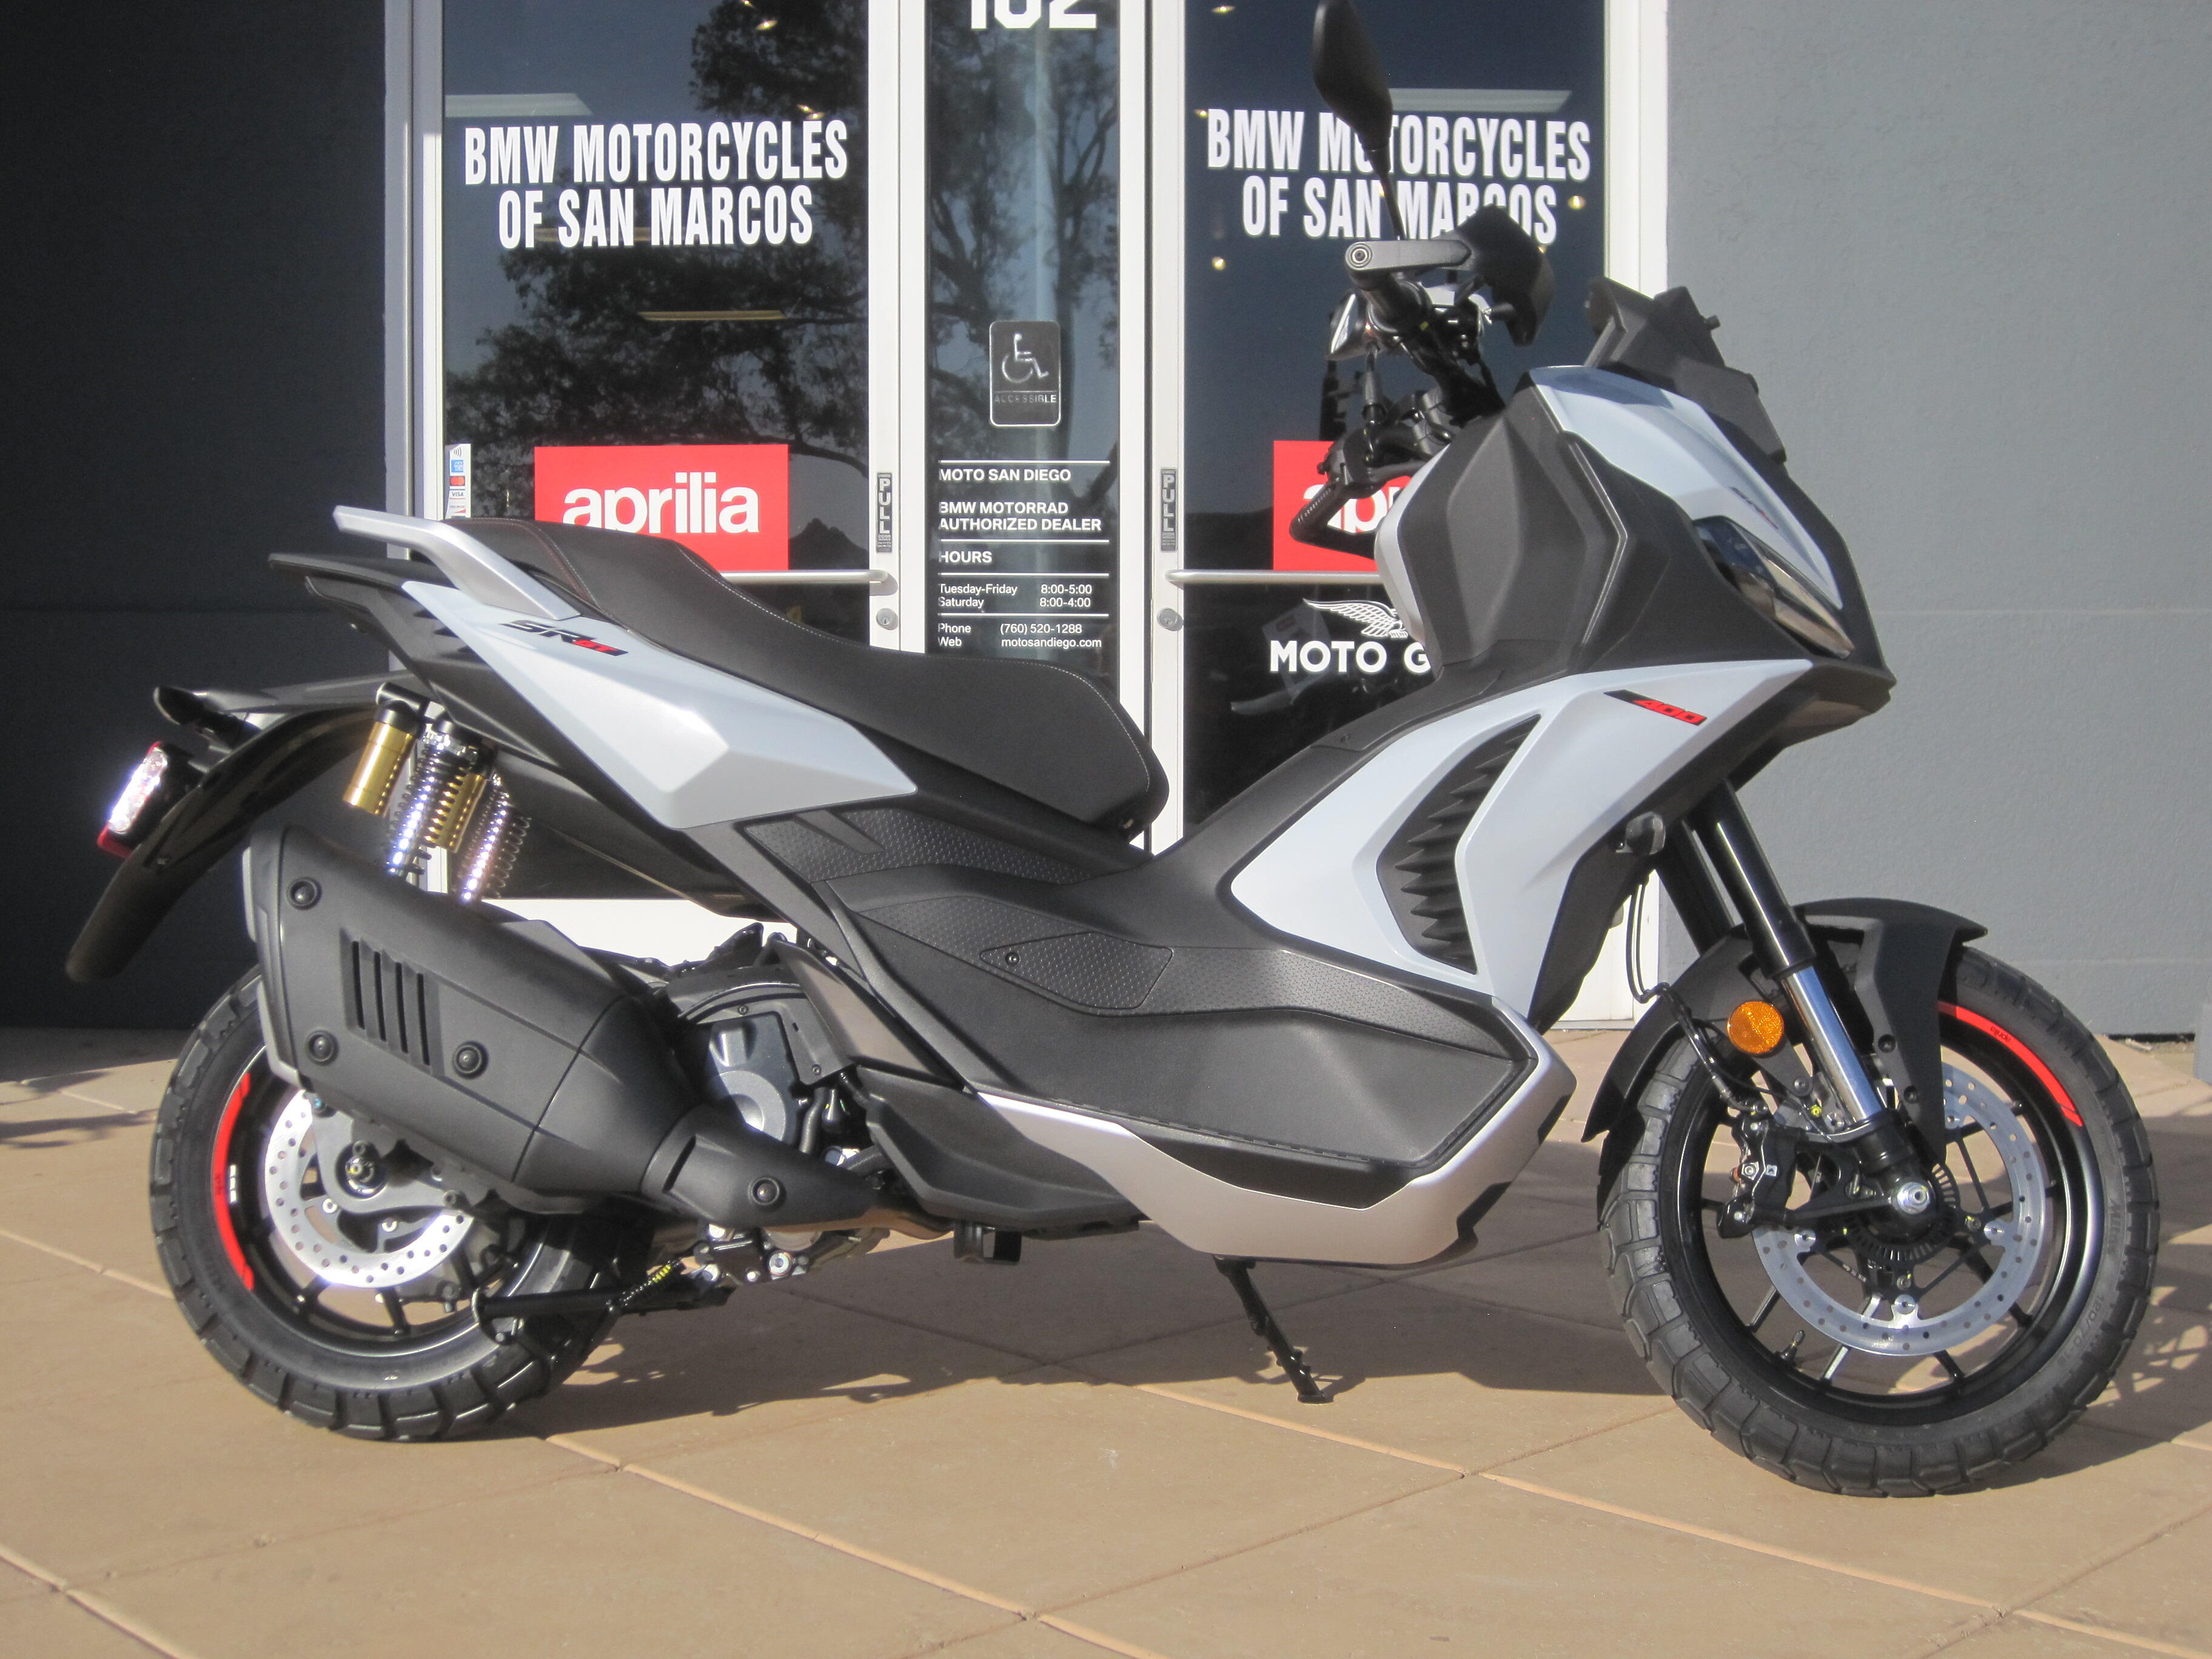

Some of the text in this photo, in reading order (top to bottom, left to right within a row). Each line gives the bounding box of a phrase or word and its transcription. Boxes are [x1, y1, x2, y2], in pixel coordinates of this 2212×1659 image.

[1208, 109, 1304, 170] BMW
[465, 120, 847, 185] BMW MOTORCYCLES
[499, 185, 813, 249] OF SAN MARCOS
[1243, 176, 1289, 236] OF
[1304, 178, 1382, 238] SAN
[939, 469, 1071, 481] MOTO SAN DIEGO
[563, 472, 759, 533] aprilia
[879, 478, 891, 534] PULL
[939, 502, 1068, 514] BMW MOTORRAD
[1162, 474, 1175, 531] PULL
[939, 518, 1102, 531] AUTHORIZED DEALER
[939, 551, 993, 563] HOURS
[938, 584, 1093, 596] Tuesday-Friday 8:00-5:00
[938, 597, 1091, 609] Saturday 8:00-4:00
[938, 623, 1082, 635] Phone (760) 520-1288
[937, 637, 1102, 649] Web motosandiego.com
[1270, 640, 1387, 673] MOTO
